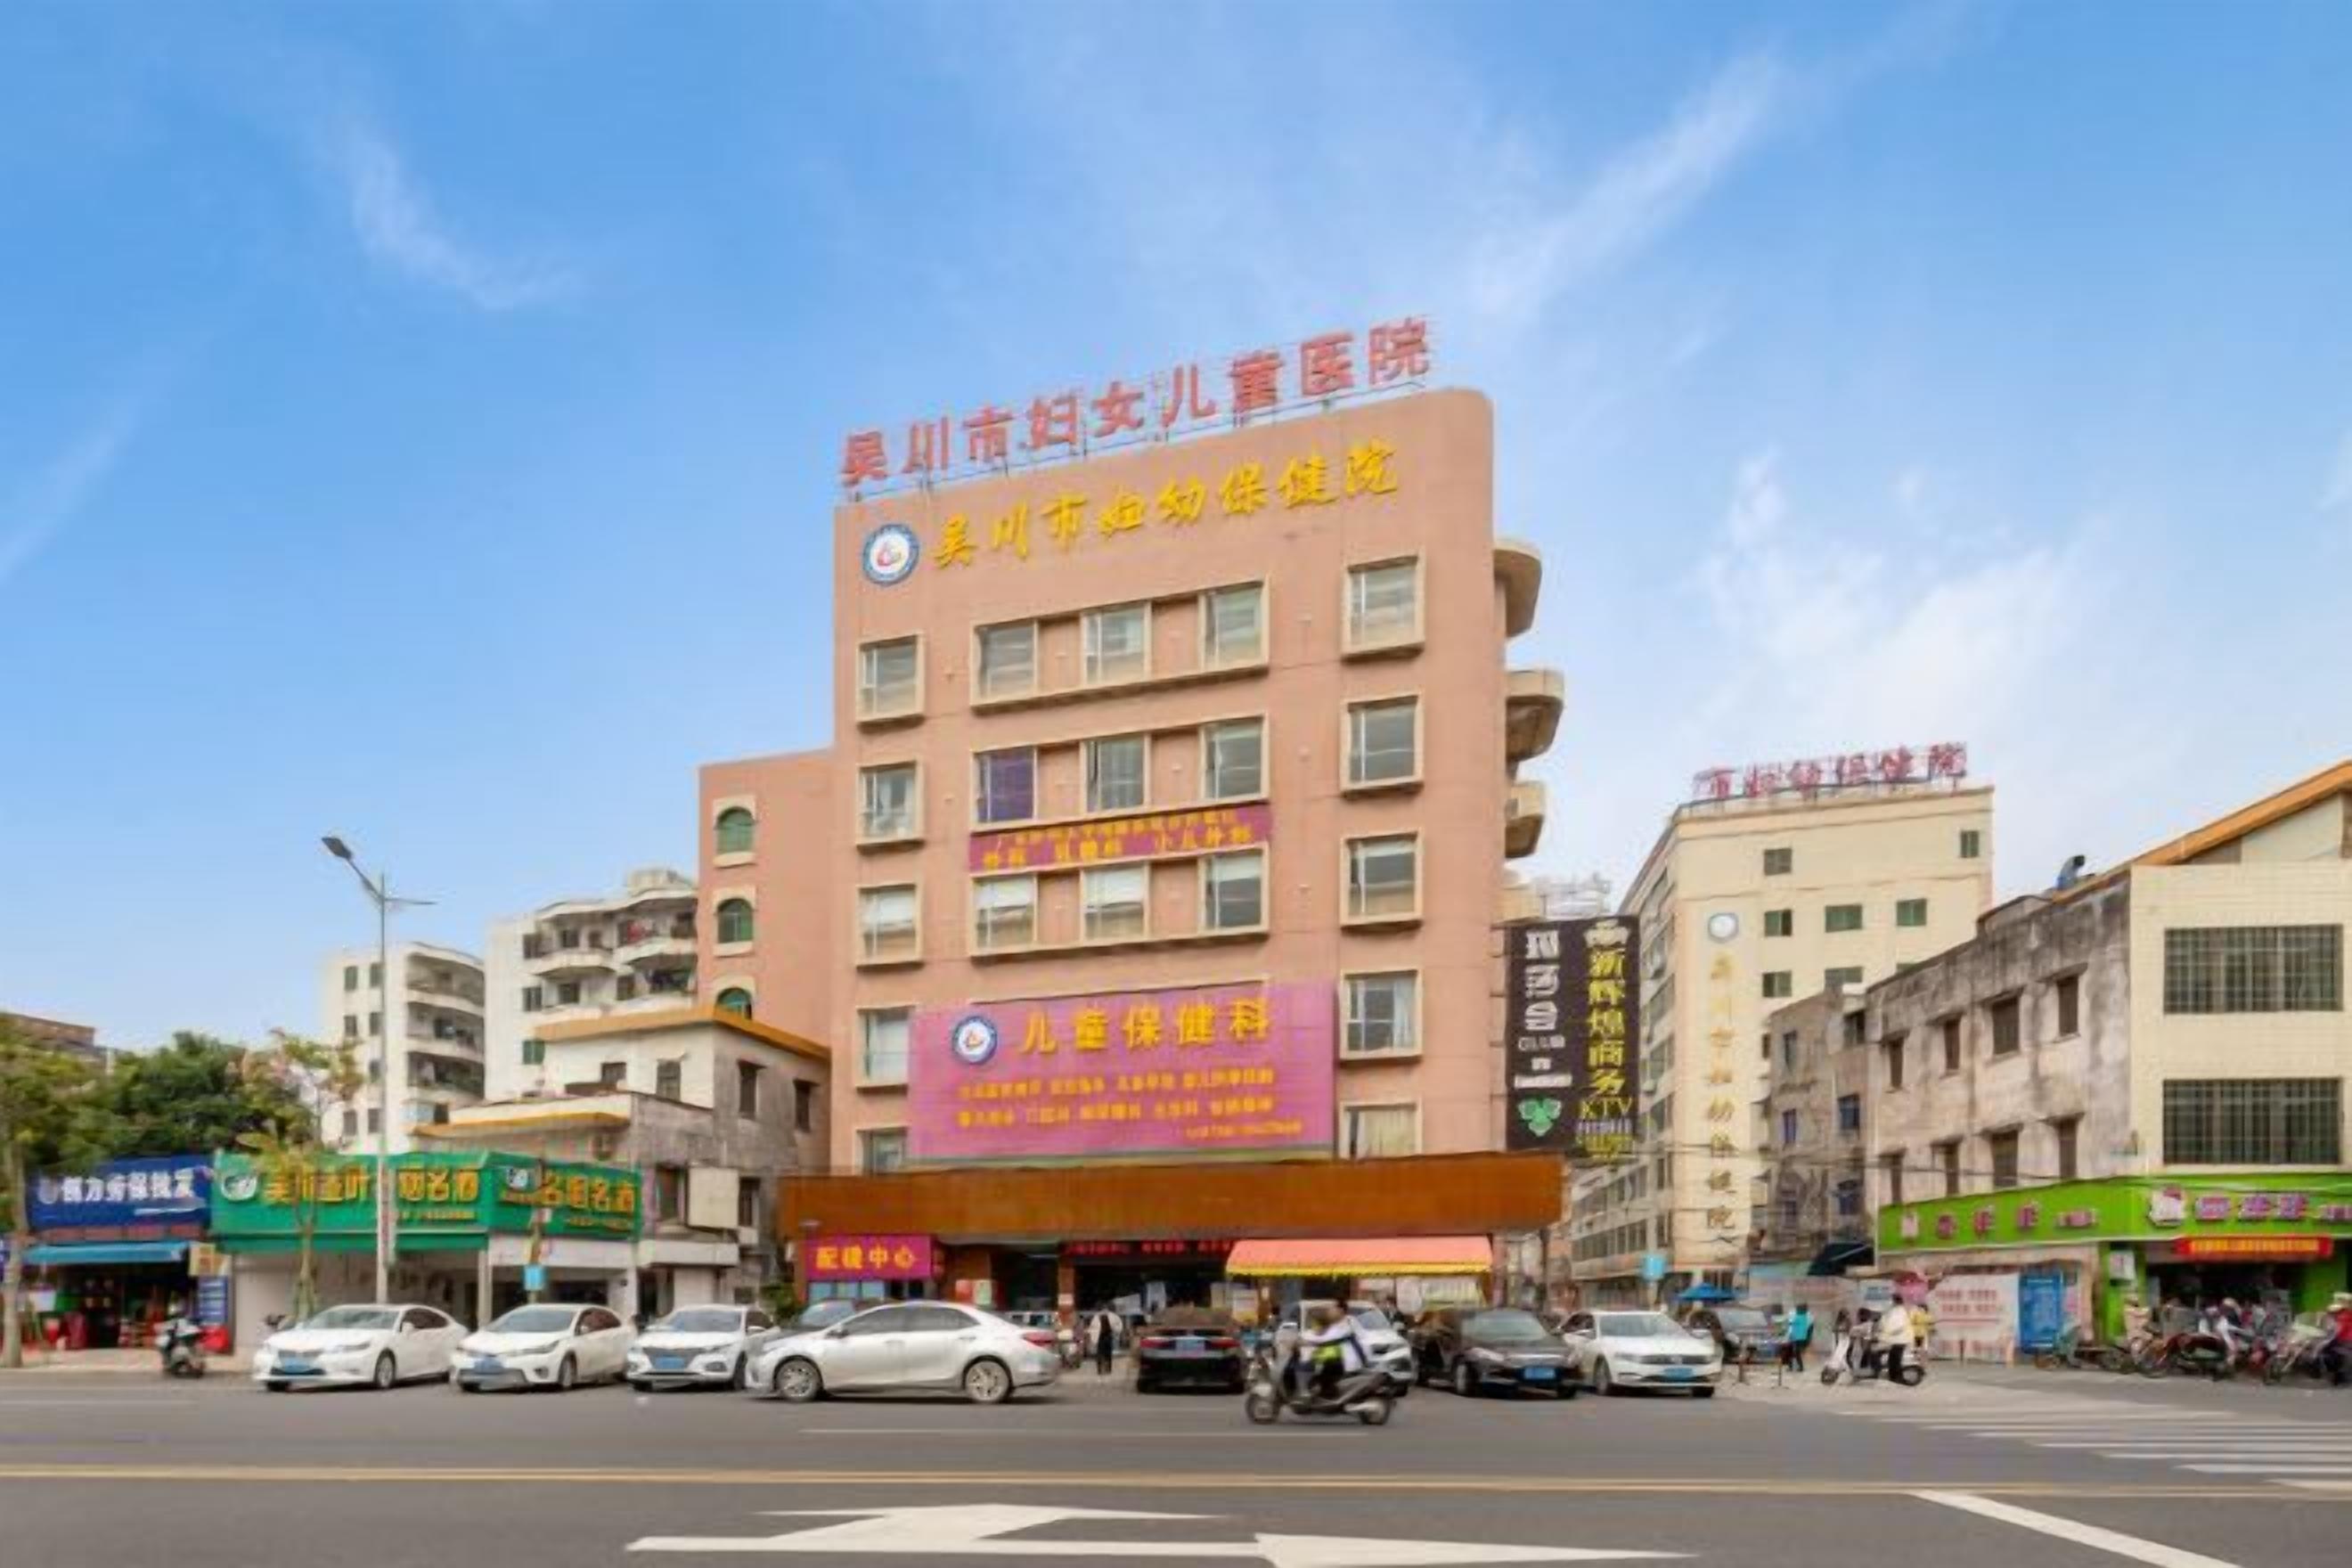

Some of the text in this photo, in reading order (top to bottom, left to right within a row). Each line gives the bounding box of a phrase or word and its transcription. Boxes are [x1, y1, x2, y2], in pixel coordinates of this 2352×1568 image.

[842, 316, 1431, 486] 吴川市妇女儿童医院
[934, 437, 1399, 570] 吴川市妇幼保健院
[1021, 999, 1271, 1054] 儿童保健科
[1580, 1097, 1633, 1120] KTV
